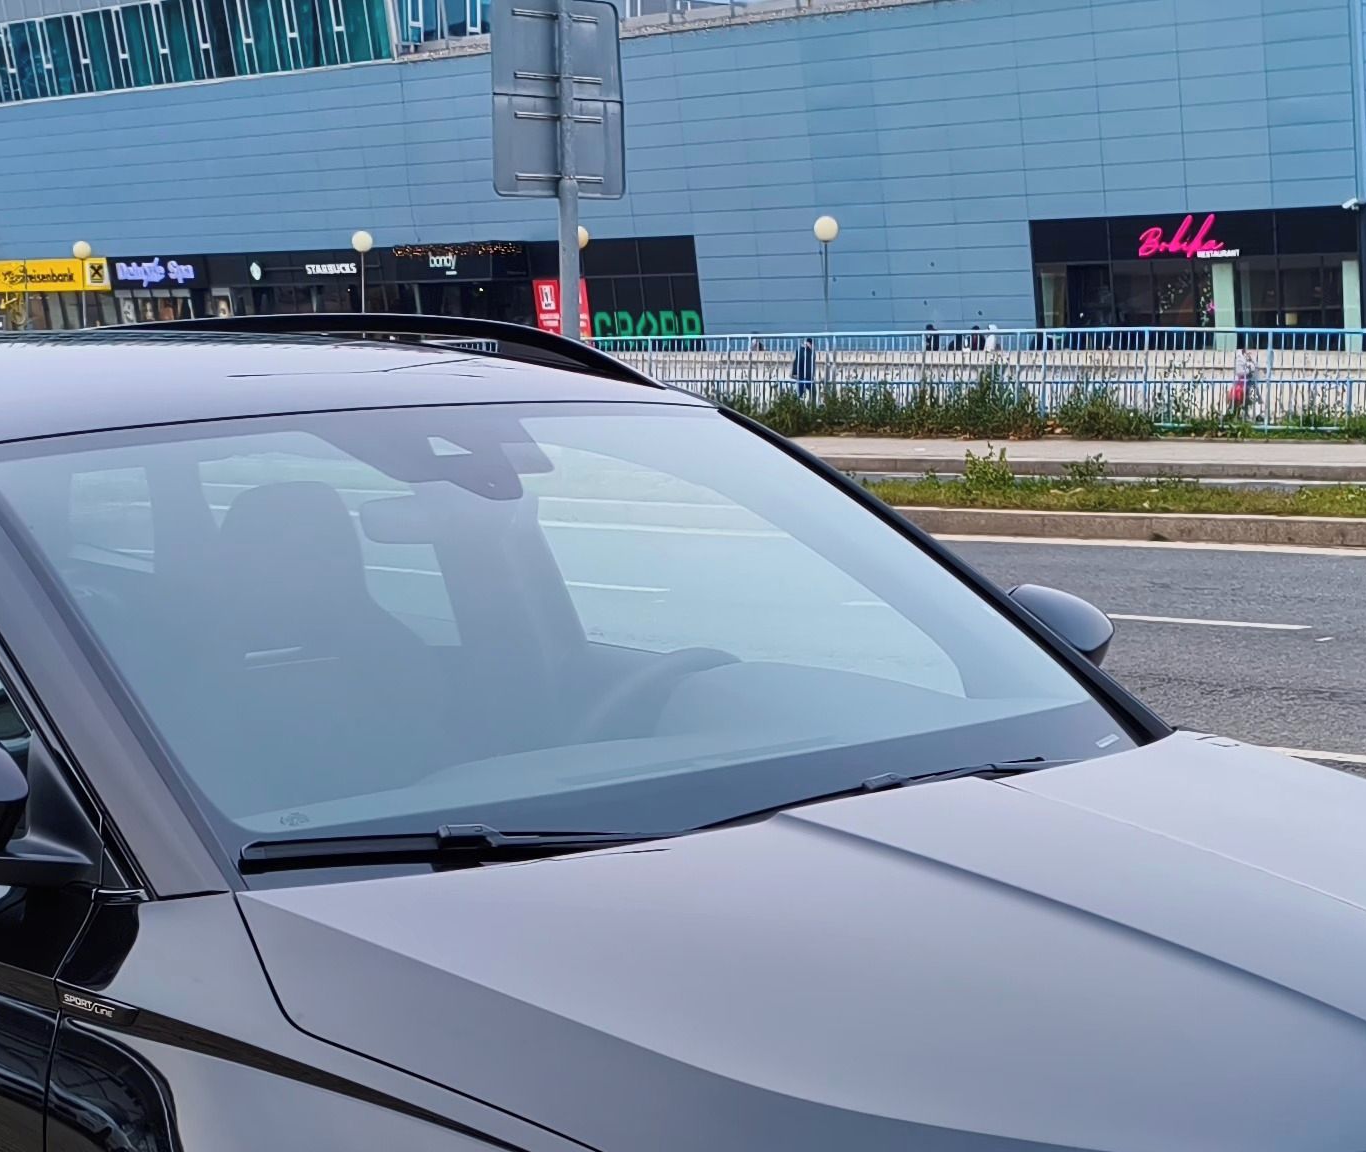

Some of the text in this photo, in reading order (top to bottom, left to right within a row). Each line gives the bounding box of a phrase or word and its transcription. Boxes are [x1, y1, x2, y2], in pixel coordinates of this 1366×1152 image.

[305, 262, 357, 274] STARBUCKS
[428, 252, 456, 269] bondy
[167, 261, 194, 283] Spa
[63, 994, 92, 1009] SPORT
